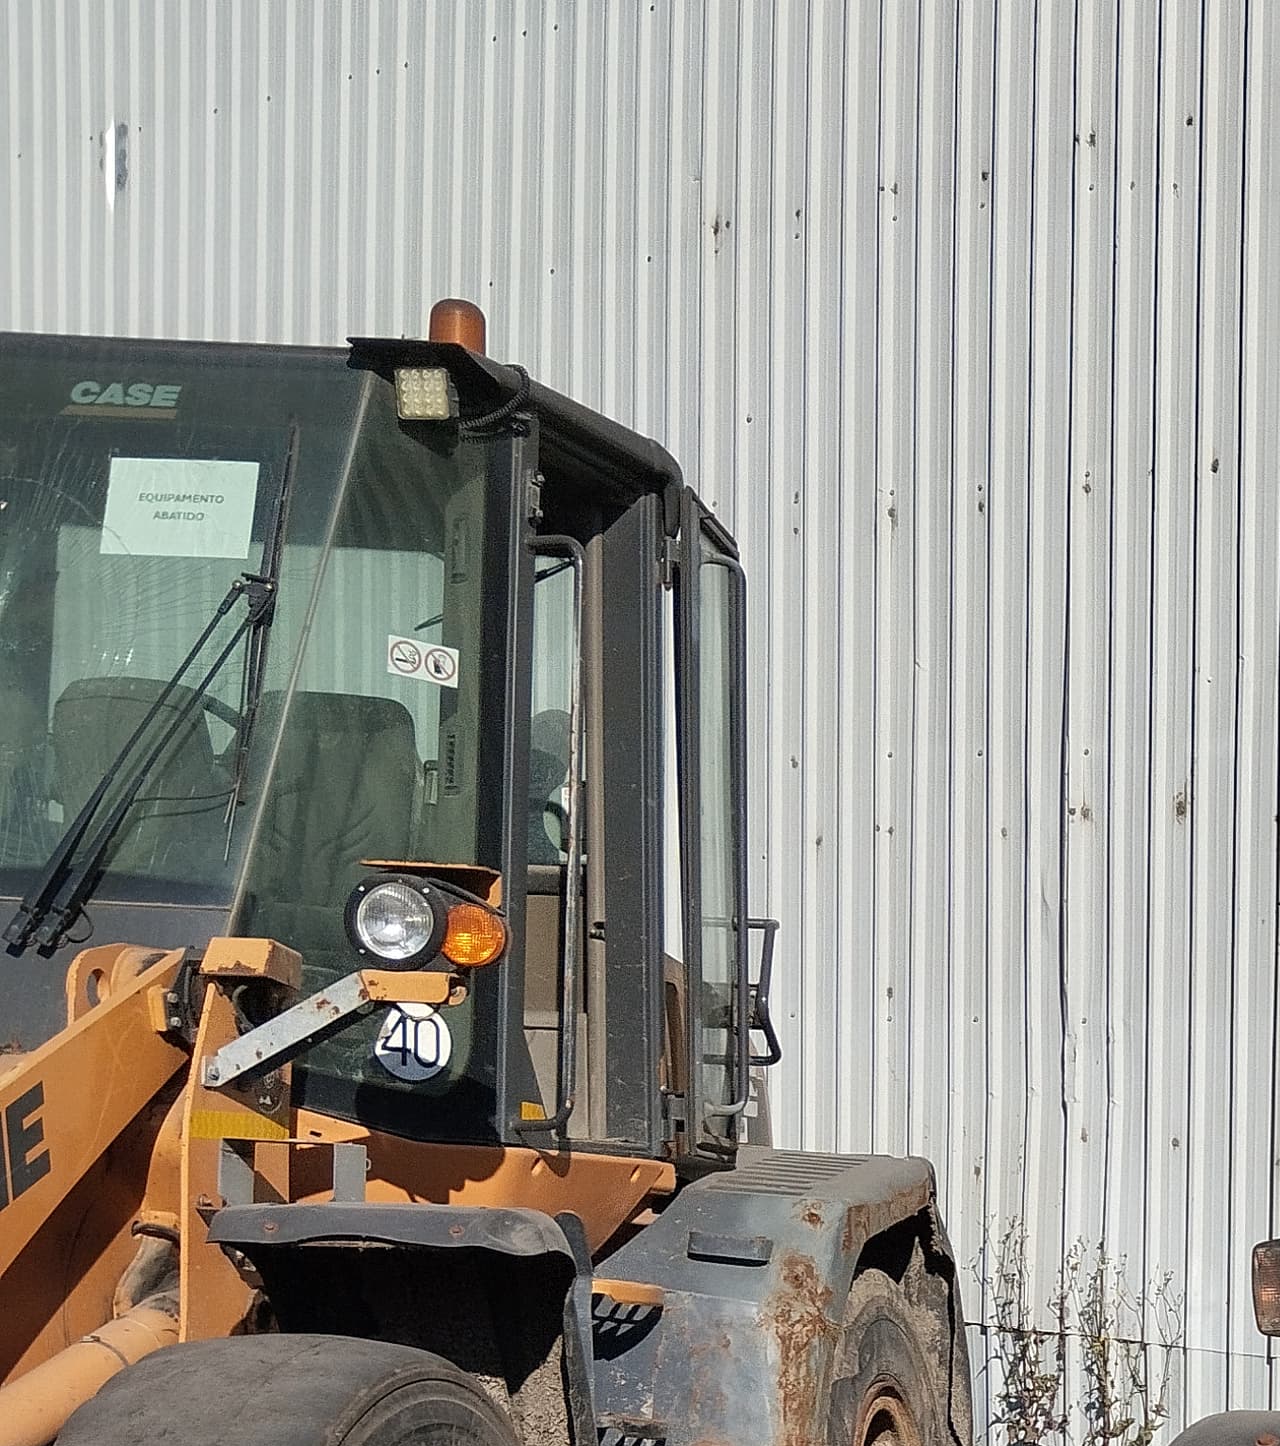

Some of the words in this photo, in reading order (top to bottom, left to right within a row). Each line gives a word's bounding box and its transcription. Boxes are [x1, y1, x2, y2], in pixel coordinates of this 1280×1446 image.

[70, 380, 182, 407] CASE
[139, 493, 225, 504] EQUIPAMENTO
[153, 510, 205, 521] ABATIDO
[381, 1014, 441, 1068] 40
